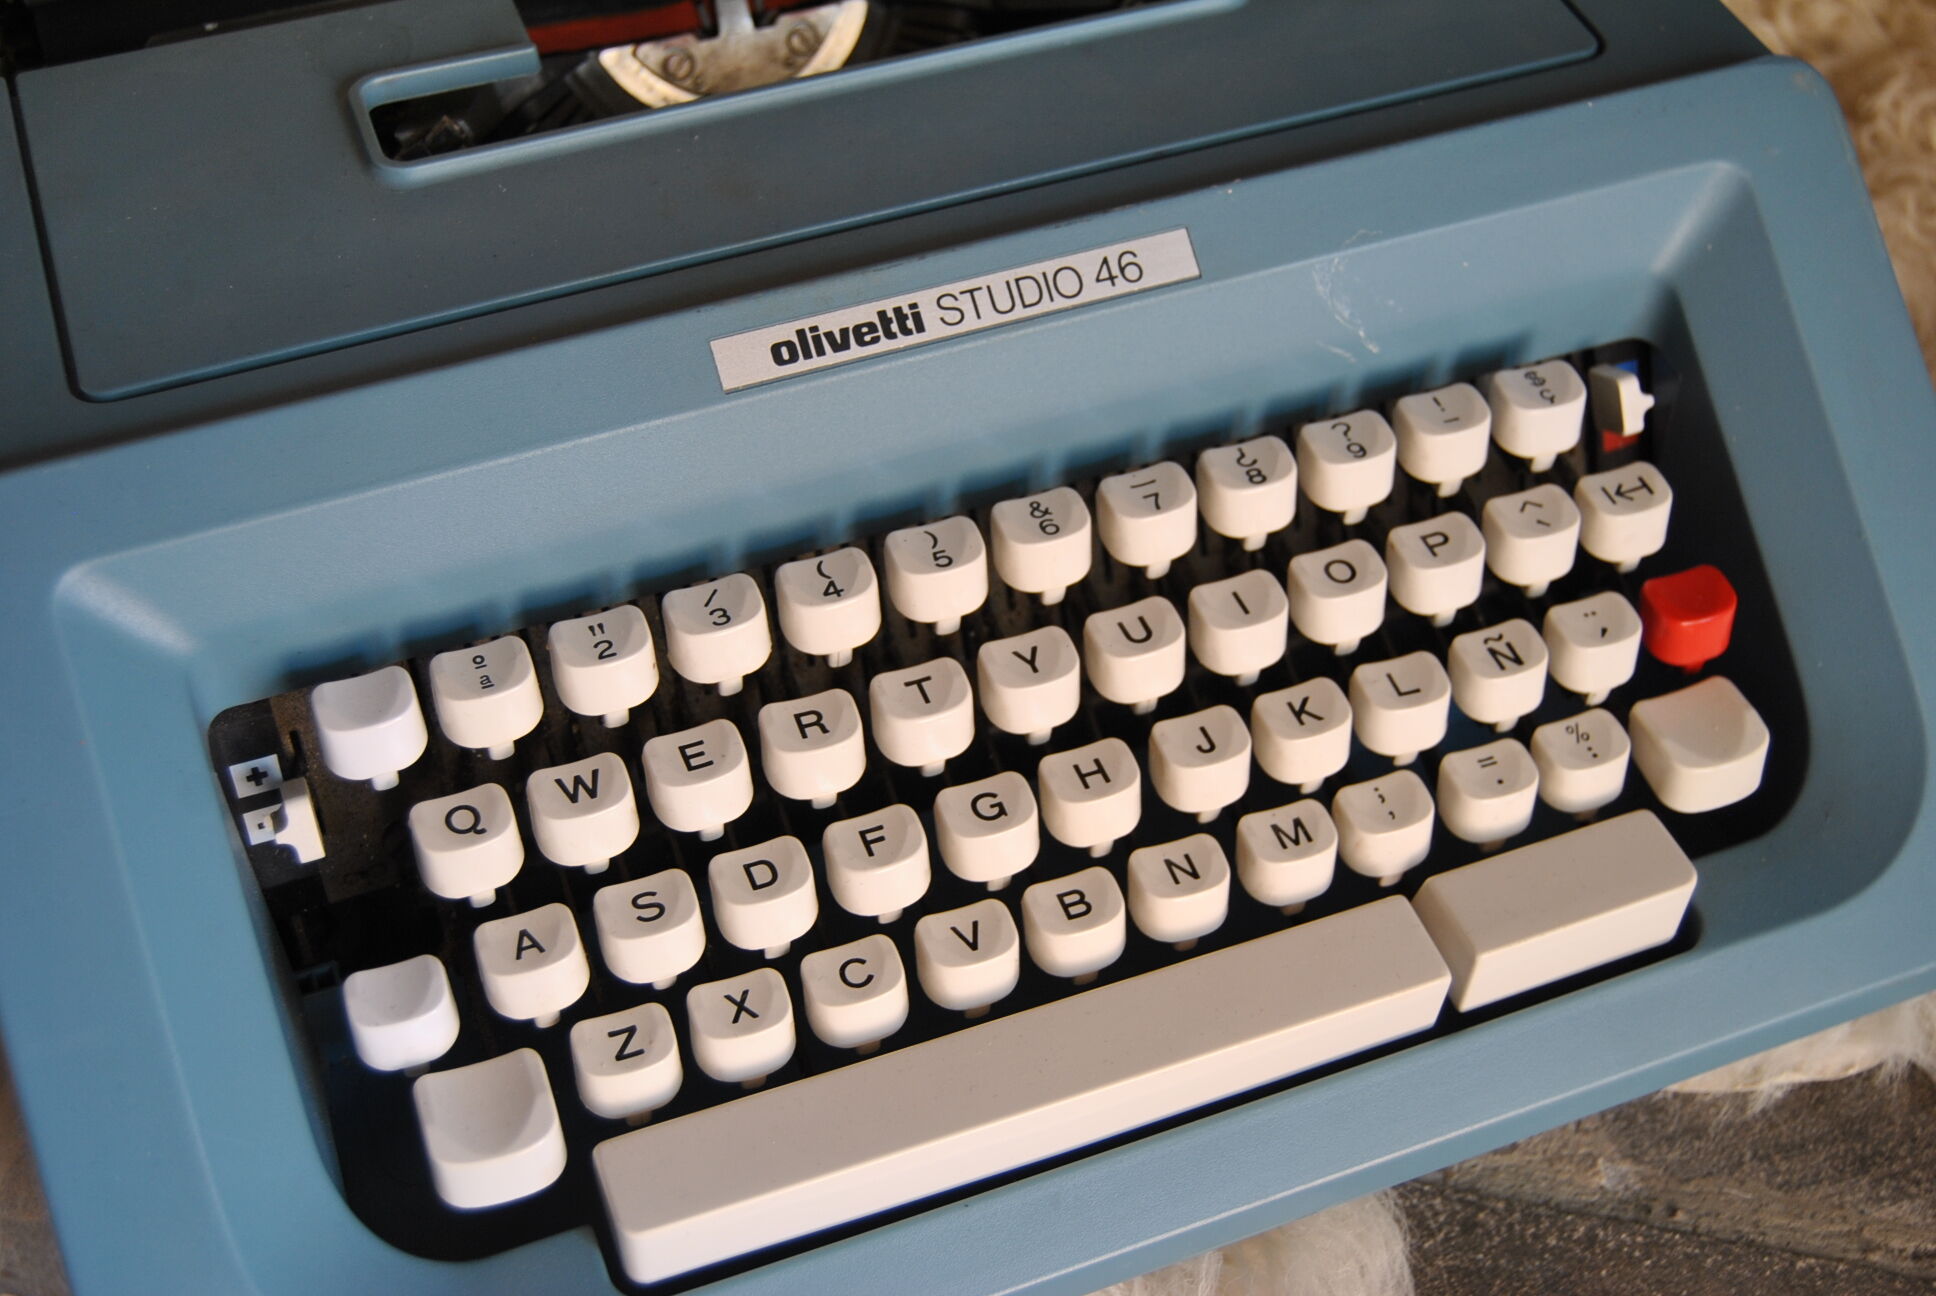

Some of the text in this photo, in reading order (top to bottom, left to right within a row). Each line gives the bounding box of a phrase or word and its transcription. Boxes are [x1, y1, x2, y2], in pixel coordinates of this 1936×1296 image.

[770, 250, 1143, 367] olivetti STUDIO 46
[1432, 397, 1446, 412] !
[1330, 422, 1353, 439] ?
[1346, 442, 1367, 458] 9
[1246, 468, 1267, 484] 8
[1029, 501, 1052, 518] &
[1143, 493, 1160, 510] 7
[923, 531, 938, 549] )
[1039, 518, 1060, 535] 6
[933, 549, 953, 567] 5
[1421, 532, 1449, 557] P
[816, 560, 832, 579] (
[1325, 560, 1356, 583] O
[704, 589, 718, 607] /
[823, 580, 844, 597] 4
[709, 608, 731, 625] 3
[1233, 592, 1249, 614] I
[1118, 616, 1152, 643] U
[594, 639, 617, 660] 2
[1013, 646, 1038, 673] Y
[1484, 634, 1524, 670] Ñ
[904, 676, 932, 704] T
[1387, 674, 1421, 696] L
[794, 710, 829, 739] R
[1288, 697, 1323, 725] K
[1197, 727, 1215, 753] J
[1565, 723, 1590, 743] %
[678, 740, 713, 771] E
[1478, 755, 1497, 769] =
[555, 769, 600, 803] W
[1073, 758, 1111, 789] H
[445, 805, 486, 834] Q
[971, 793, 1007, 821] G
[859, 825, 885, 857] F
[1271, 818, 1312, 849] M
[743, 860, 778, 890] D
[1165, 854, 1200, 884] N
[632, 892, 665, 922] S
[1057, 890, 1092, 920] B
[516, 929, 545, 960] A
[951, 921, 978, 951] V
[839, 958, 874, 988] C
[724, 990, 759, 1024] X
[608, 1025, 644, 1061] Z
